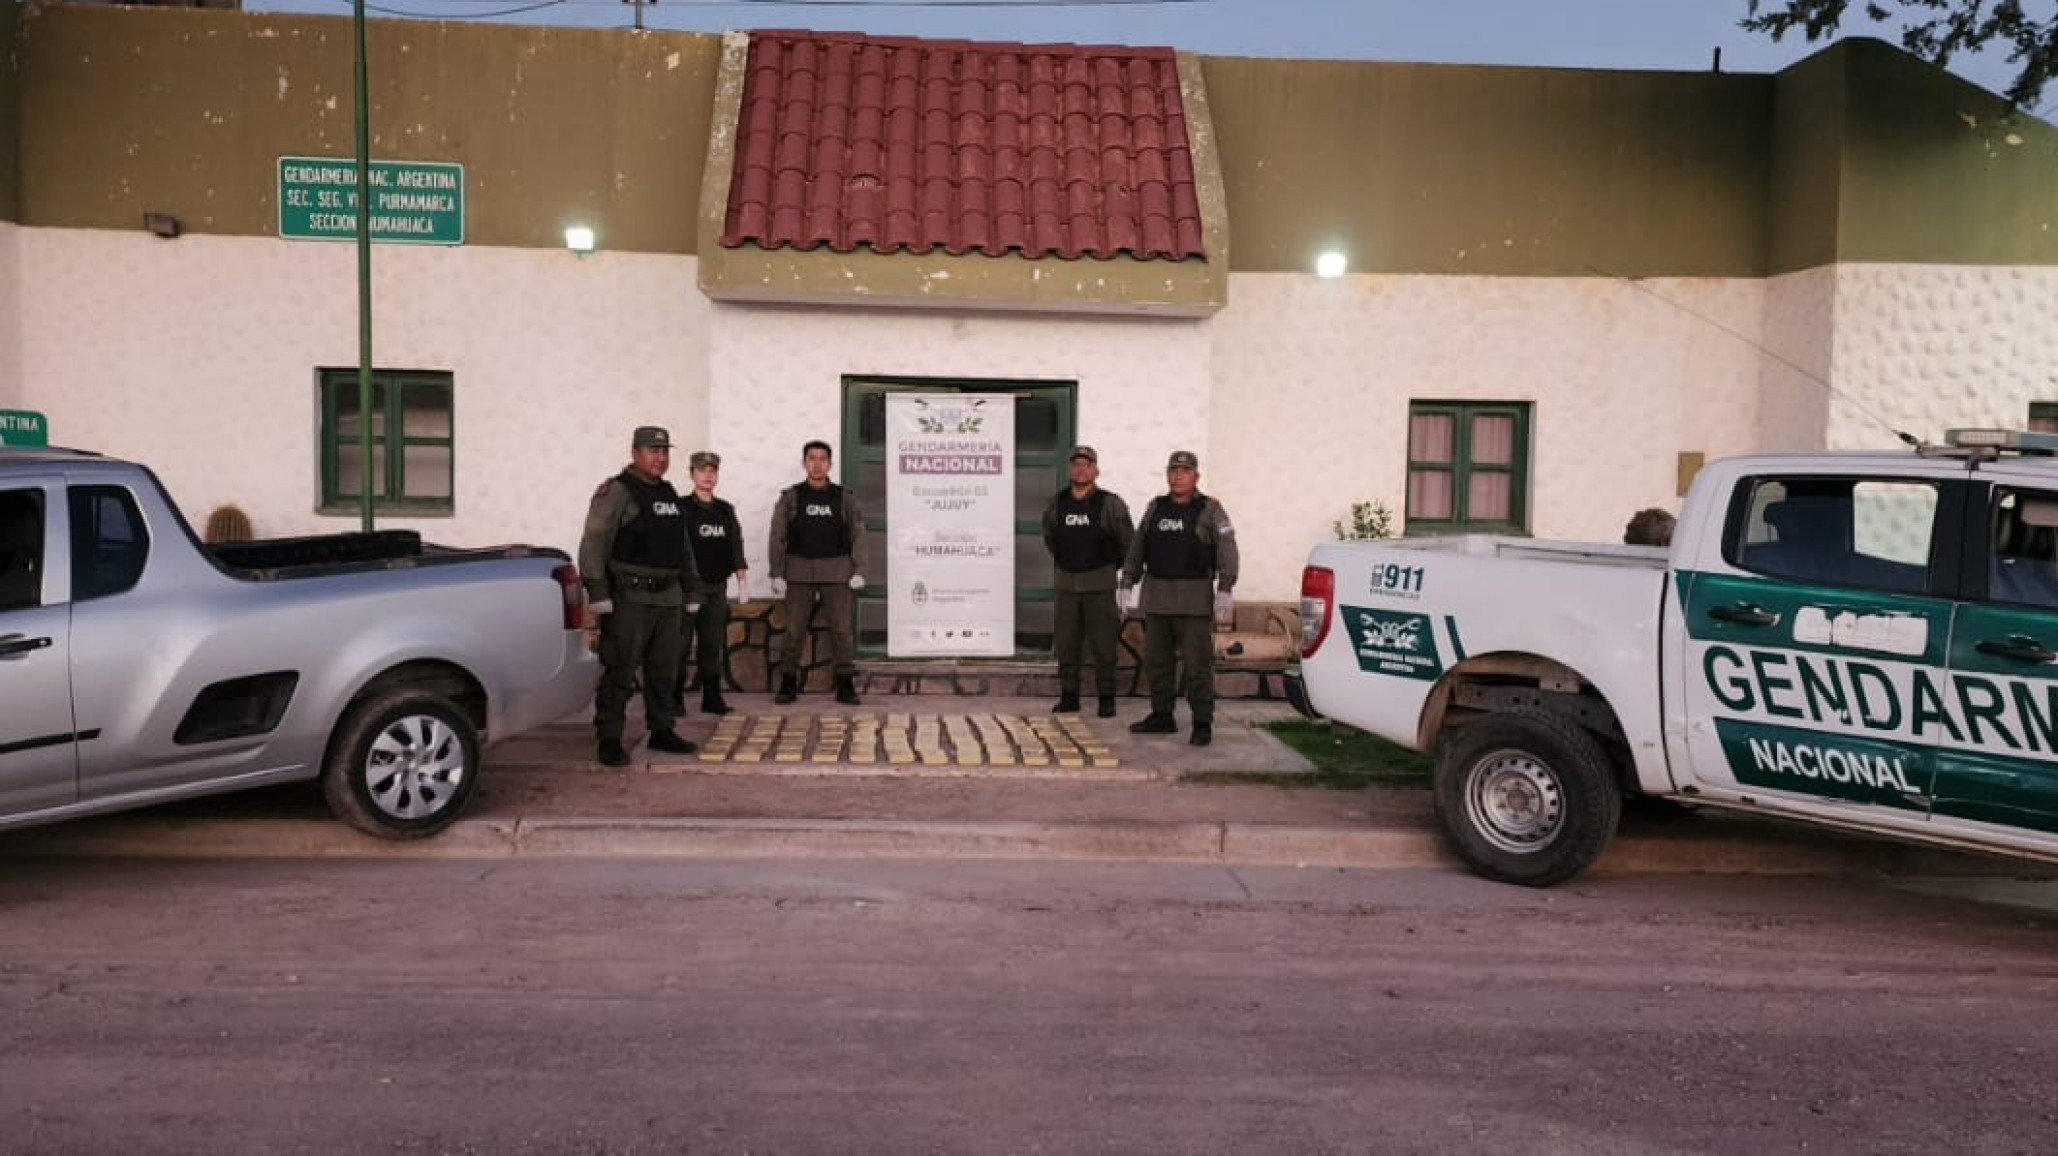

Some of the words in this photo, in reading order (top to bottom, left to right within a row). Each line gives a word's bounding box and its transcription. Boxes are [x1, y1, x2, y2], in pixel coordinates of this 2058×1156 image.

[397, 170, 456, 189] ARGENTINA
[286, 190, 312, 206] SEC.
[906, 458, 999, 472] NACIONAL
[653, 501, 680, 516] GNA
[806, 504, 832, 516] GNA
[1065, 514, 1090, 526] GNA
[1158, 518, 1184, 532] GNA
[699, 524, 725, 537] GNA
[1385, 564, 1425, 592] 911
[1750, 738, 1921, 793] NACIONAL
